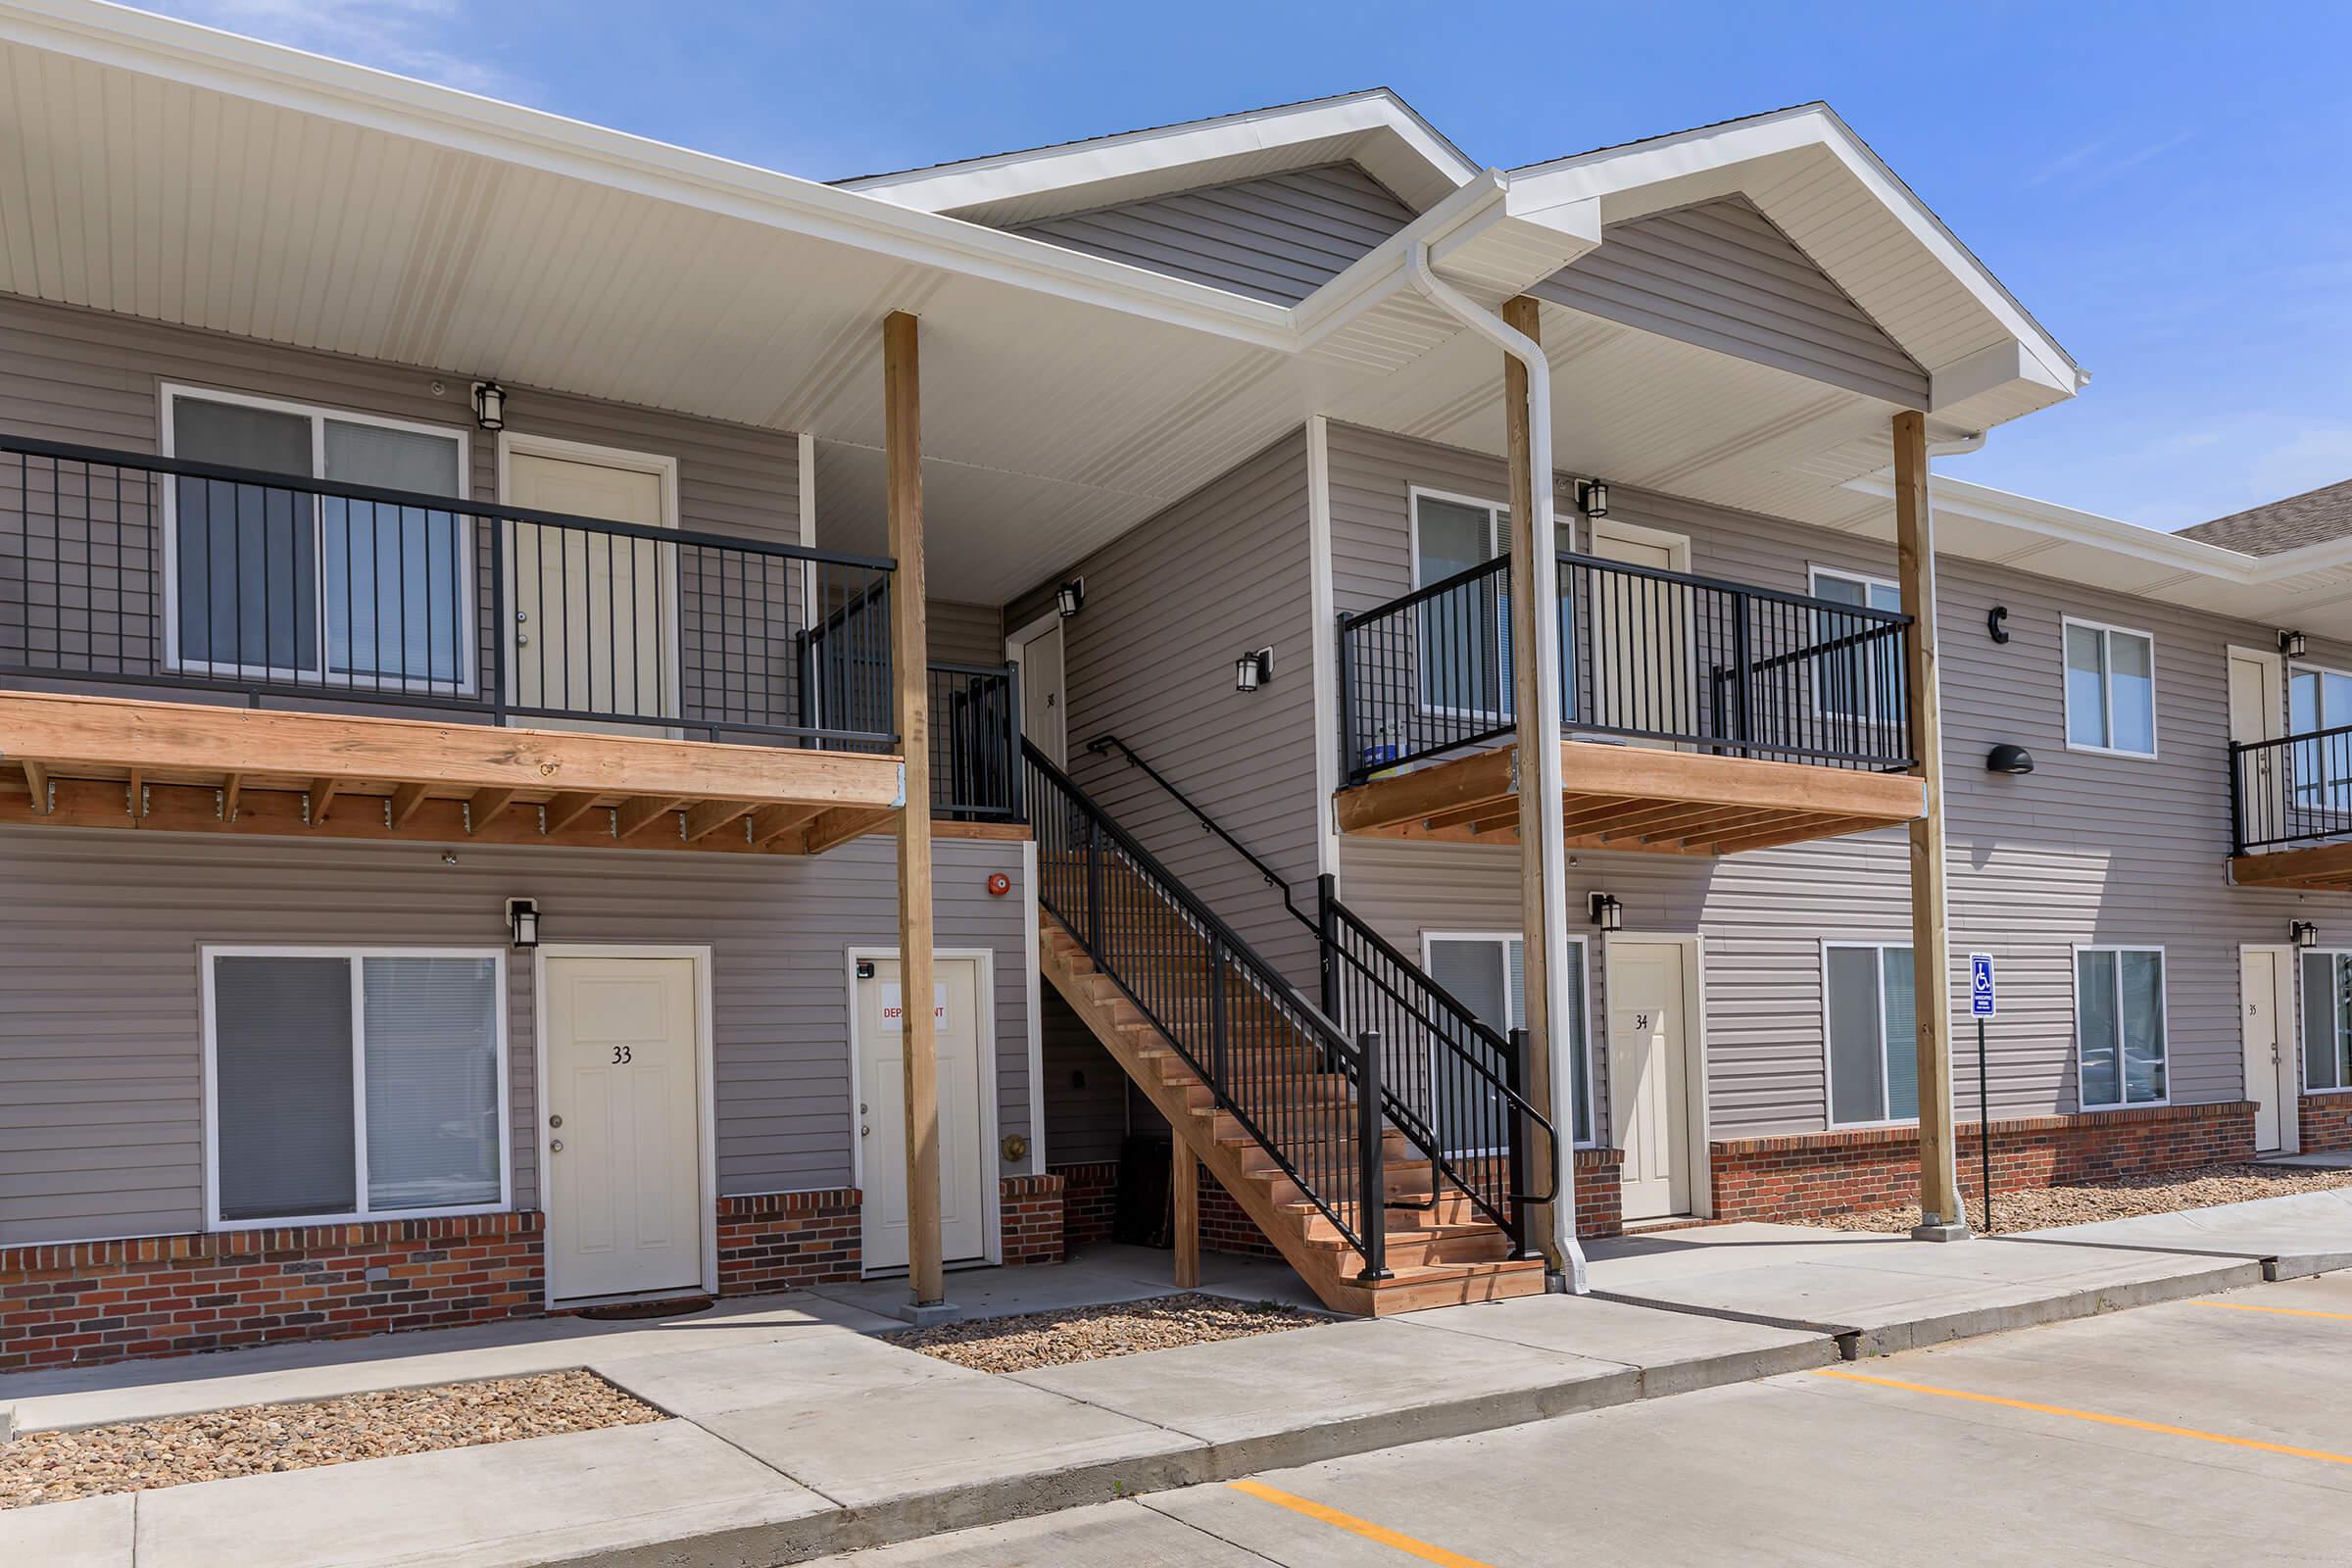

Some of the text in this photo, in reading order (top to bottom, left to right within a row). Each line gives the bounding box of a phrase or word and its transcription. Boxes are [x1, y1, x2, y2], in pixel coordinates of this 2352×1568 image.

[1987, 606, 2009, 644] C
[1636, 1014, 1647, 1030] 34
[612, 1046, 632, 1064] 33
